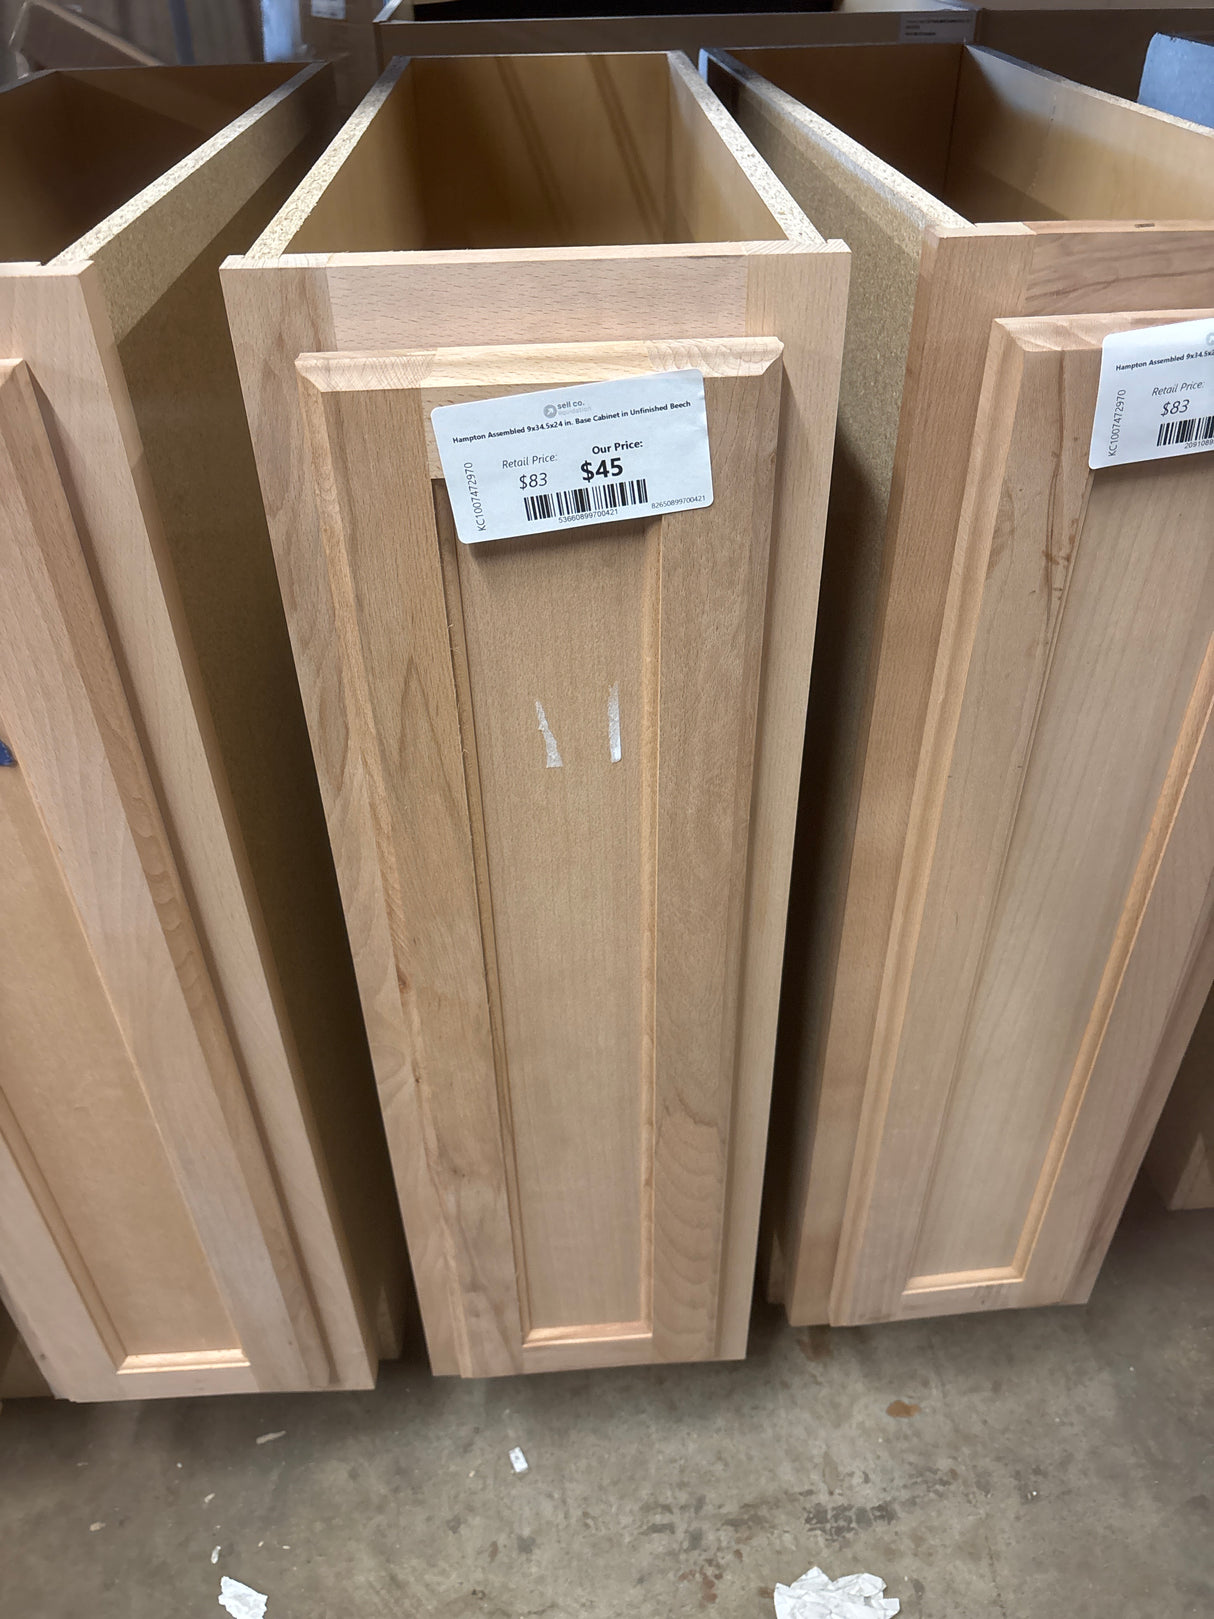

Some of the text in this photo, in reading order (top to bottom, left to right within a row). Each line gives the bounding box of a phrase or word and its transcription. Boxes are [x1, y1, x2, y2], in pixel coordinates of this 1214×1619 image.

[1116, 362, 1147, 371] Hampton
[1149, 354, 1184, 366] Assembled
[1152, 380, 1205, 396] Retail Price:
[557, 401, 571, 409] sell
[1160, 399, 1190, 416] $83
[452, 432, 486, 444] Hampton
[488, 426, 526, 439] Assembled
[564, 419, 573, 427] in.
[575, 415, 591, 425] Base
[593, 410, 620, 422] Cabinet
[621, 409, 629, 417] in
[630, 403, 668, 416] Unfinished
[670, 400, 691, 410] Beech
[1108, 389, 1126, 456] KC1007472970
[592, 439, 643, 455] Our Price:
[502, 453, 558, 469] Retail Price:
[580, 457, 624, 482] $45
[519, 472, 548, 490] $83
[463, 462, 486, 531] KC1007472970
